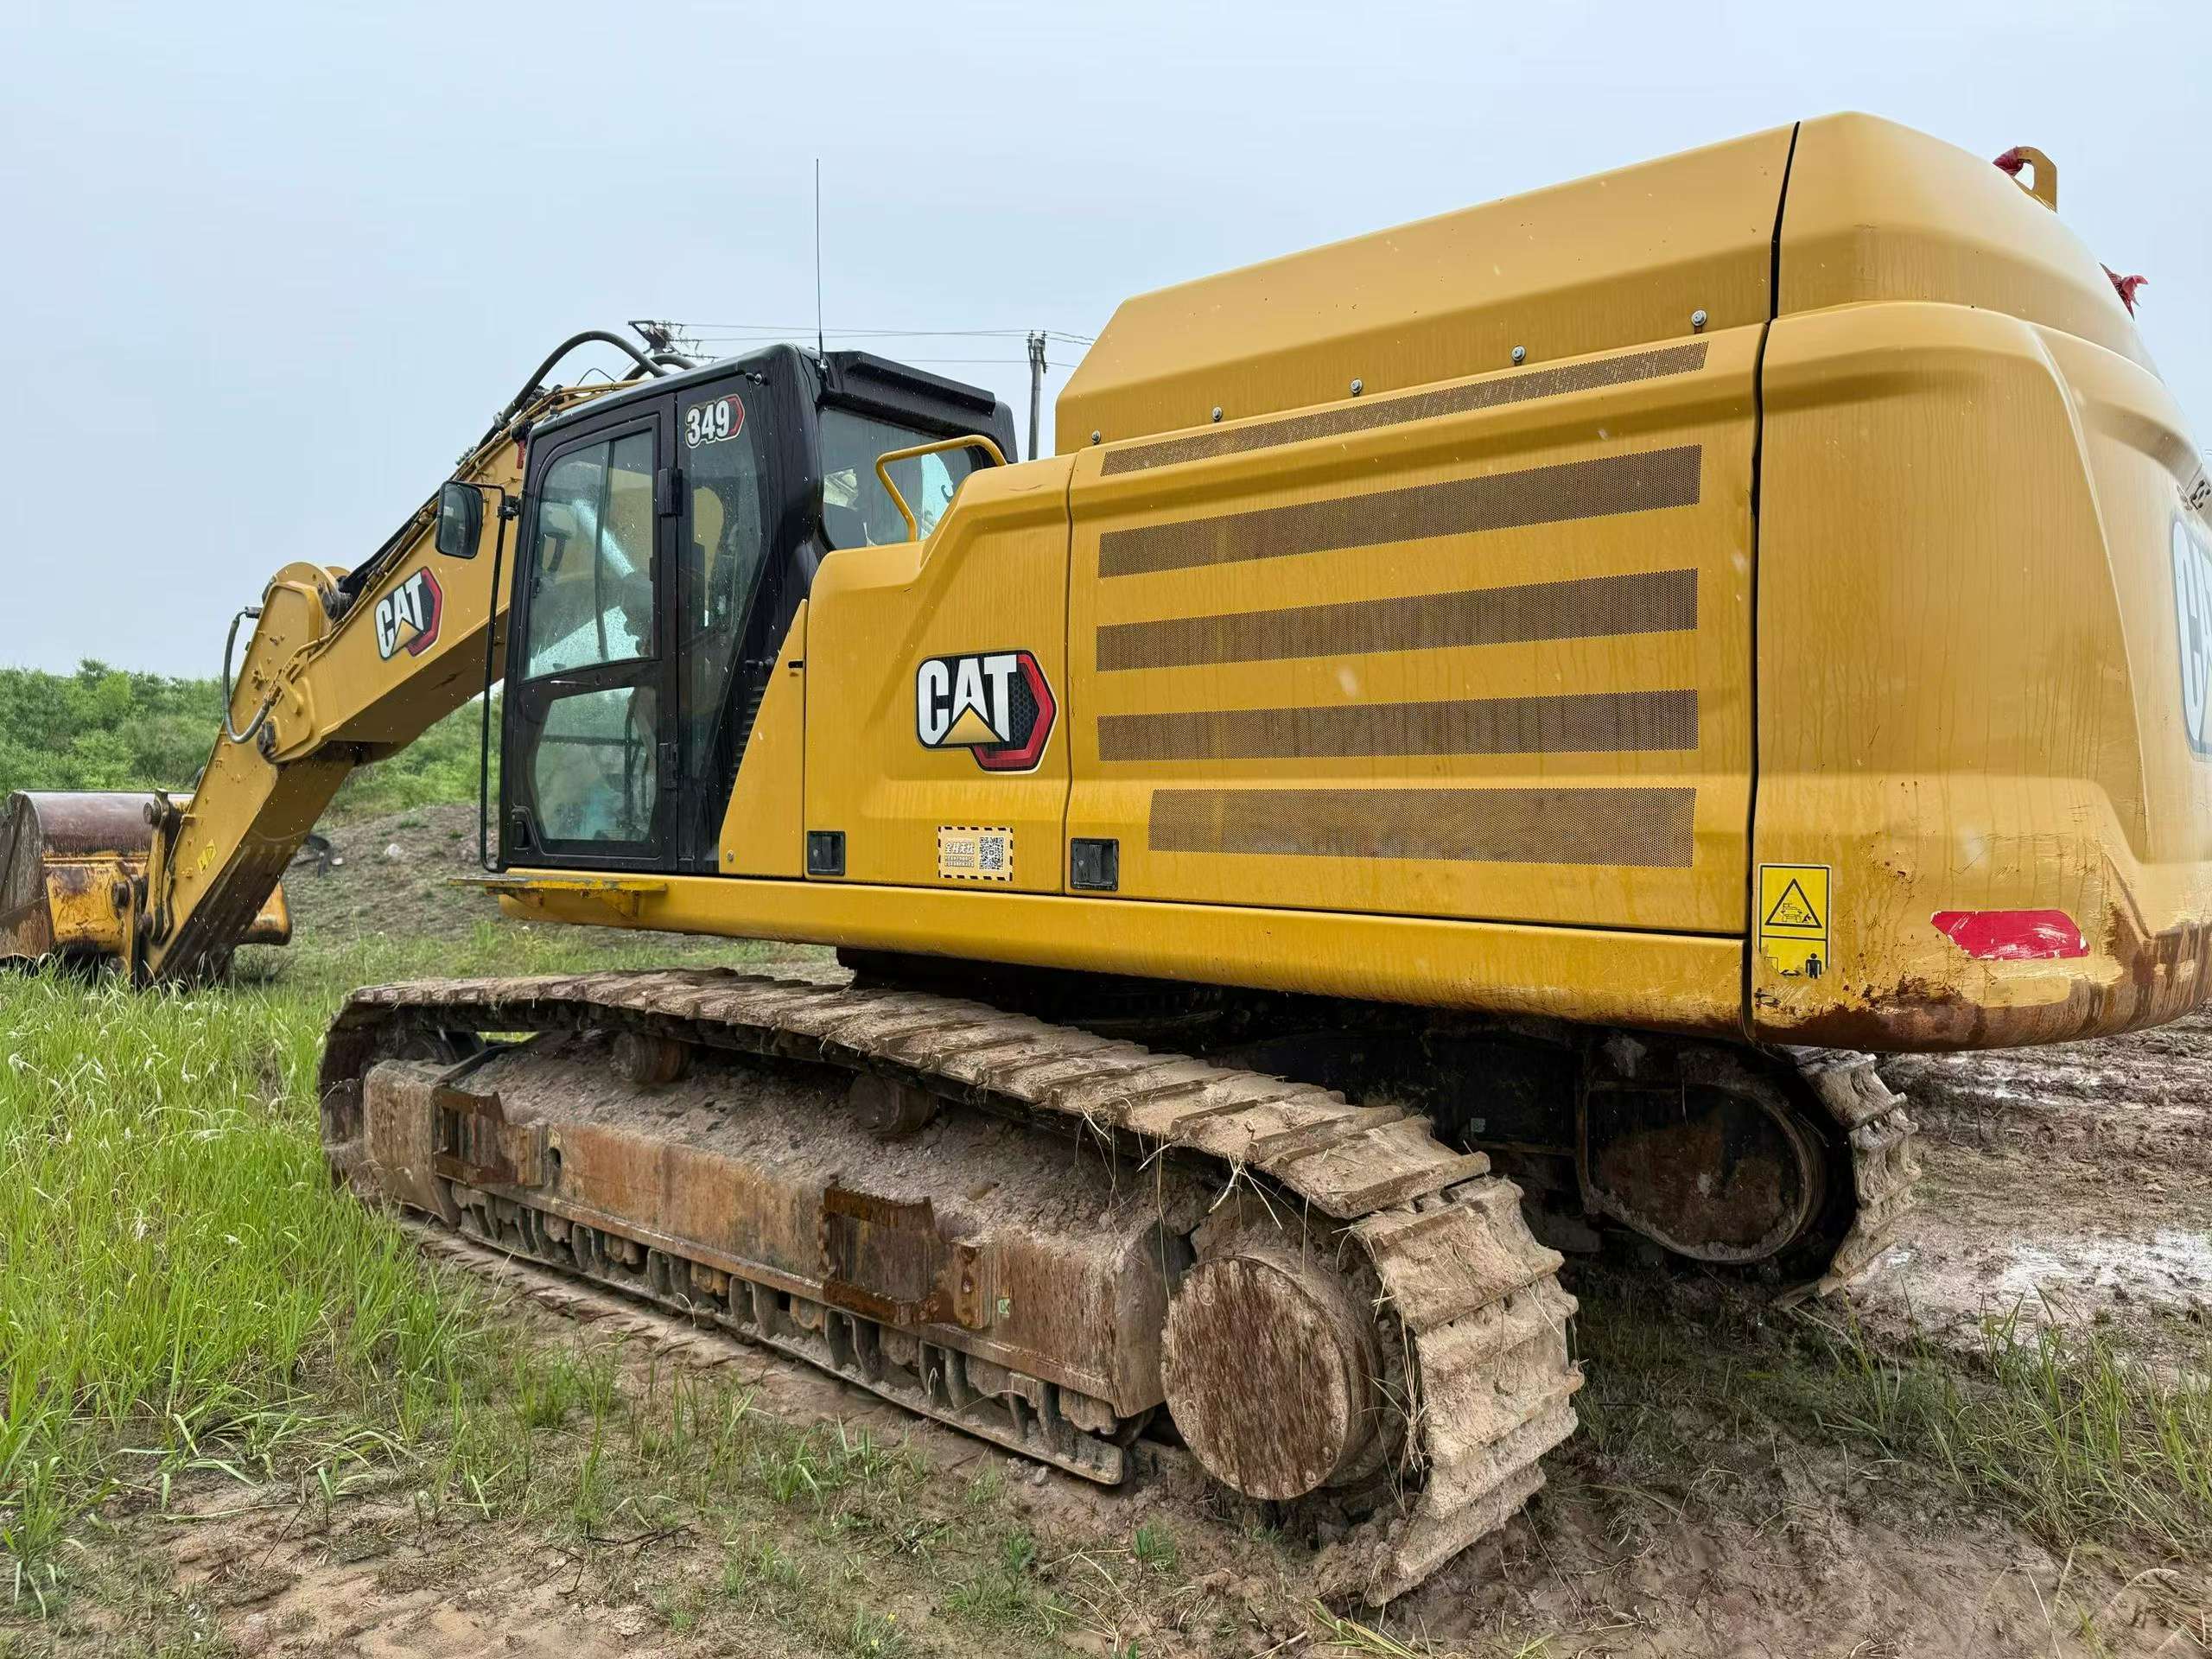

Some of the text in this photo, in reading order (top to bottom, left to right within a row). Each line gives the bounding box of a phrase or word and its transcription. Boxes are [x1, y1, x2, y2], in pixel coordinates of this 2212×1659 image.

[687, 400, 730, 445] 349
[375, 571, 424, 658] CAT
[2172, 520, 2212, 741] CA
[918, 654, 1017, 745] CAT
